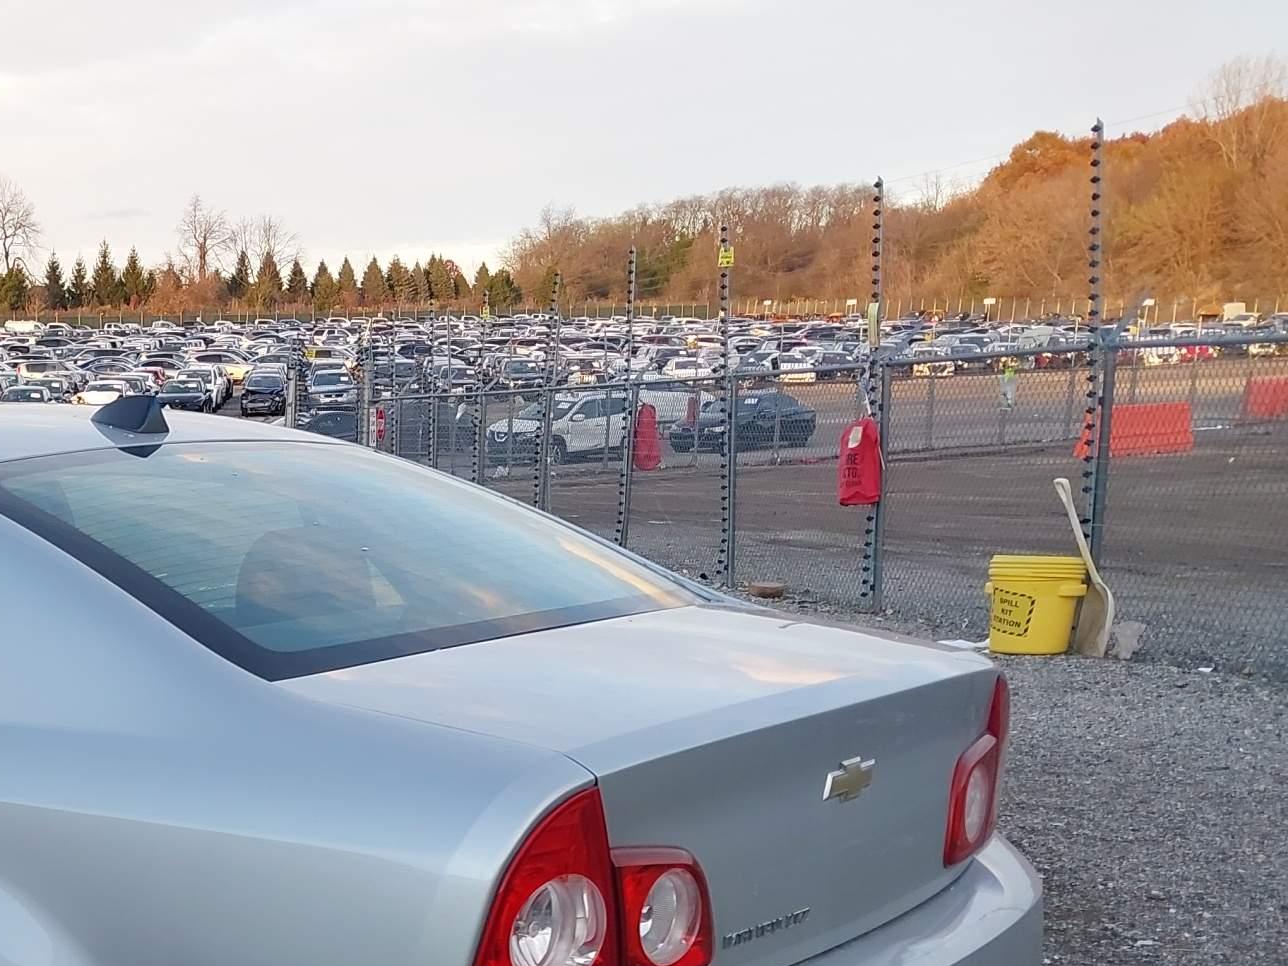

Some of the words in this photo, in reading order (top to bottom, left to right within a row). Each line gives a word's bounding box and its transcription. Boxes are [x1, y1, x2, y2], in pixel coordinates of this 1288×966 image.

[999, 597, 1020, 608] SPILL
[1001, 608, 1013, 616] KIT
[994, 615, 1021, 628] STATION
